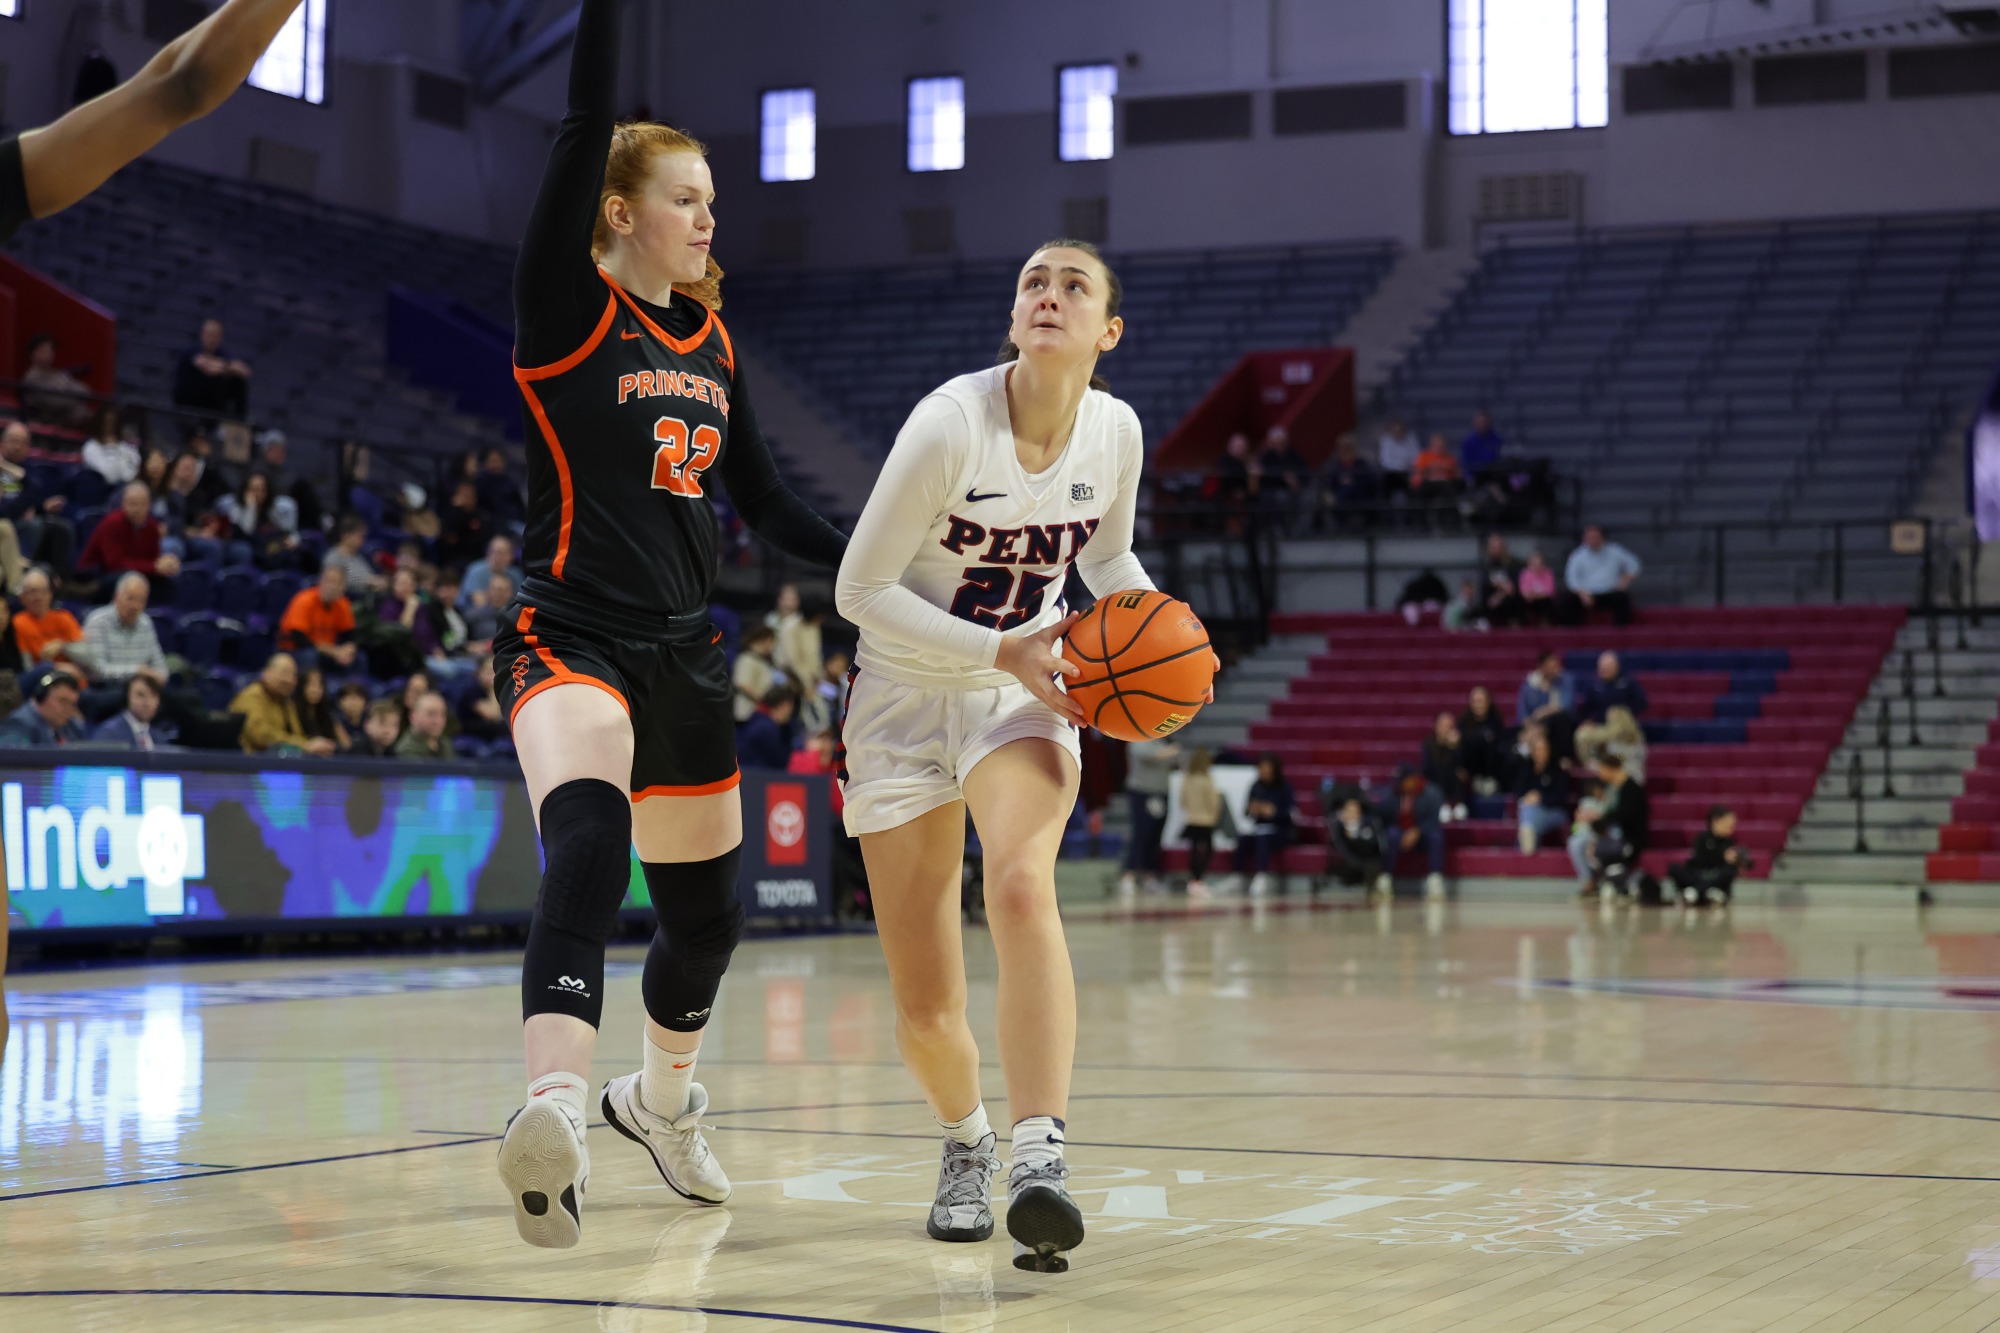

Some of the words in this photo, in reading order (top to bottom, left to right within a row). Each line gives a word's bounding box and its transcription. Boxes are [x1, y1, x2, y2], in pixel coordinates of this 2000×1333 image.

[651, 416, 721, 498] 22
[1078, 486, 1095, 497] IVY
[940, 514, 1100, 565] PENN
[950, 567, 1059, 632] 25
[755, 879, 818, 908] TOYOTA
[1083, 1219, 1298, 1242] TH
